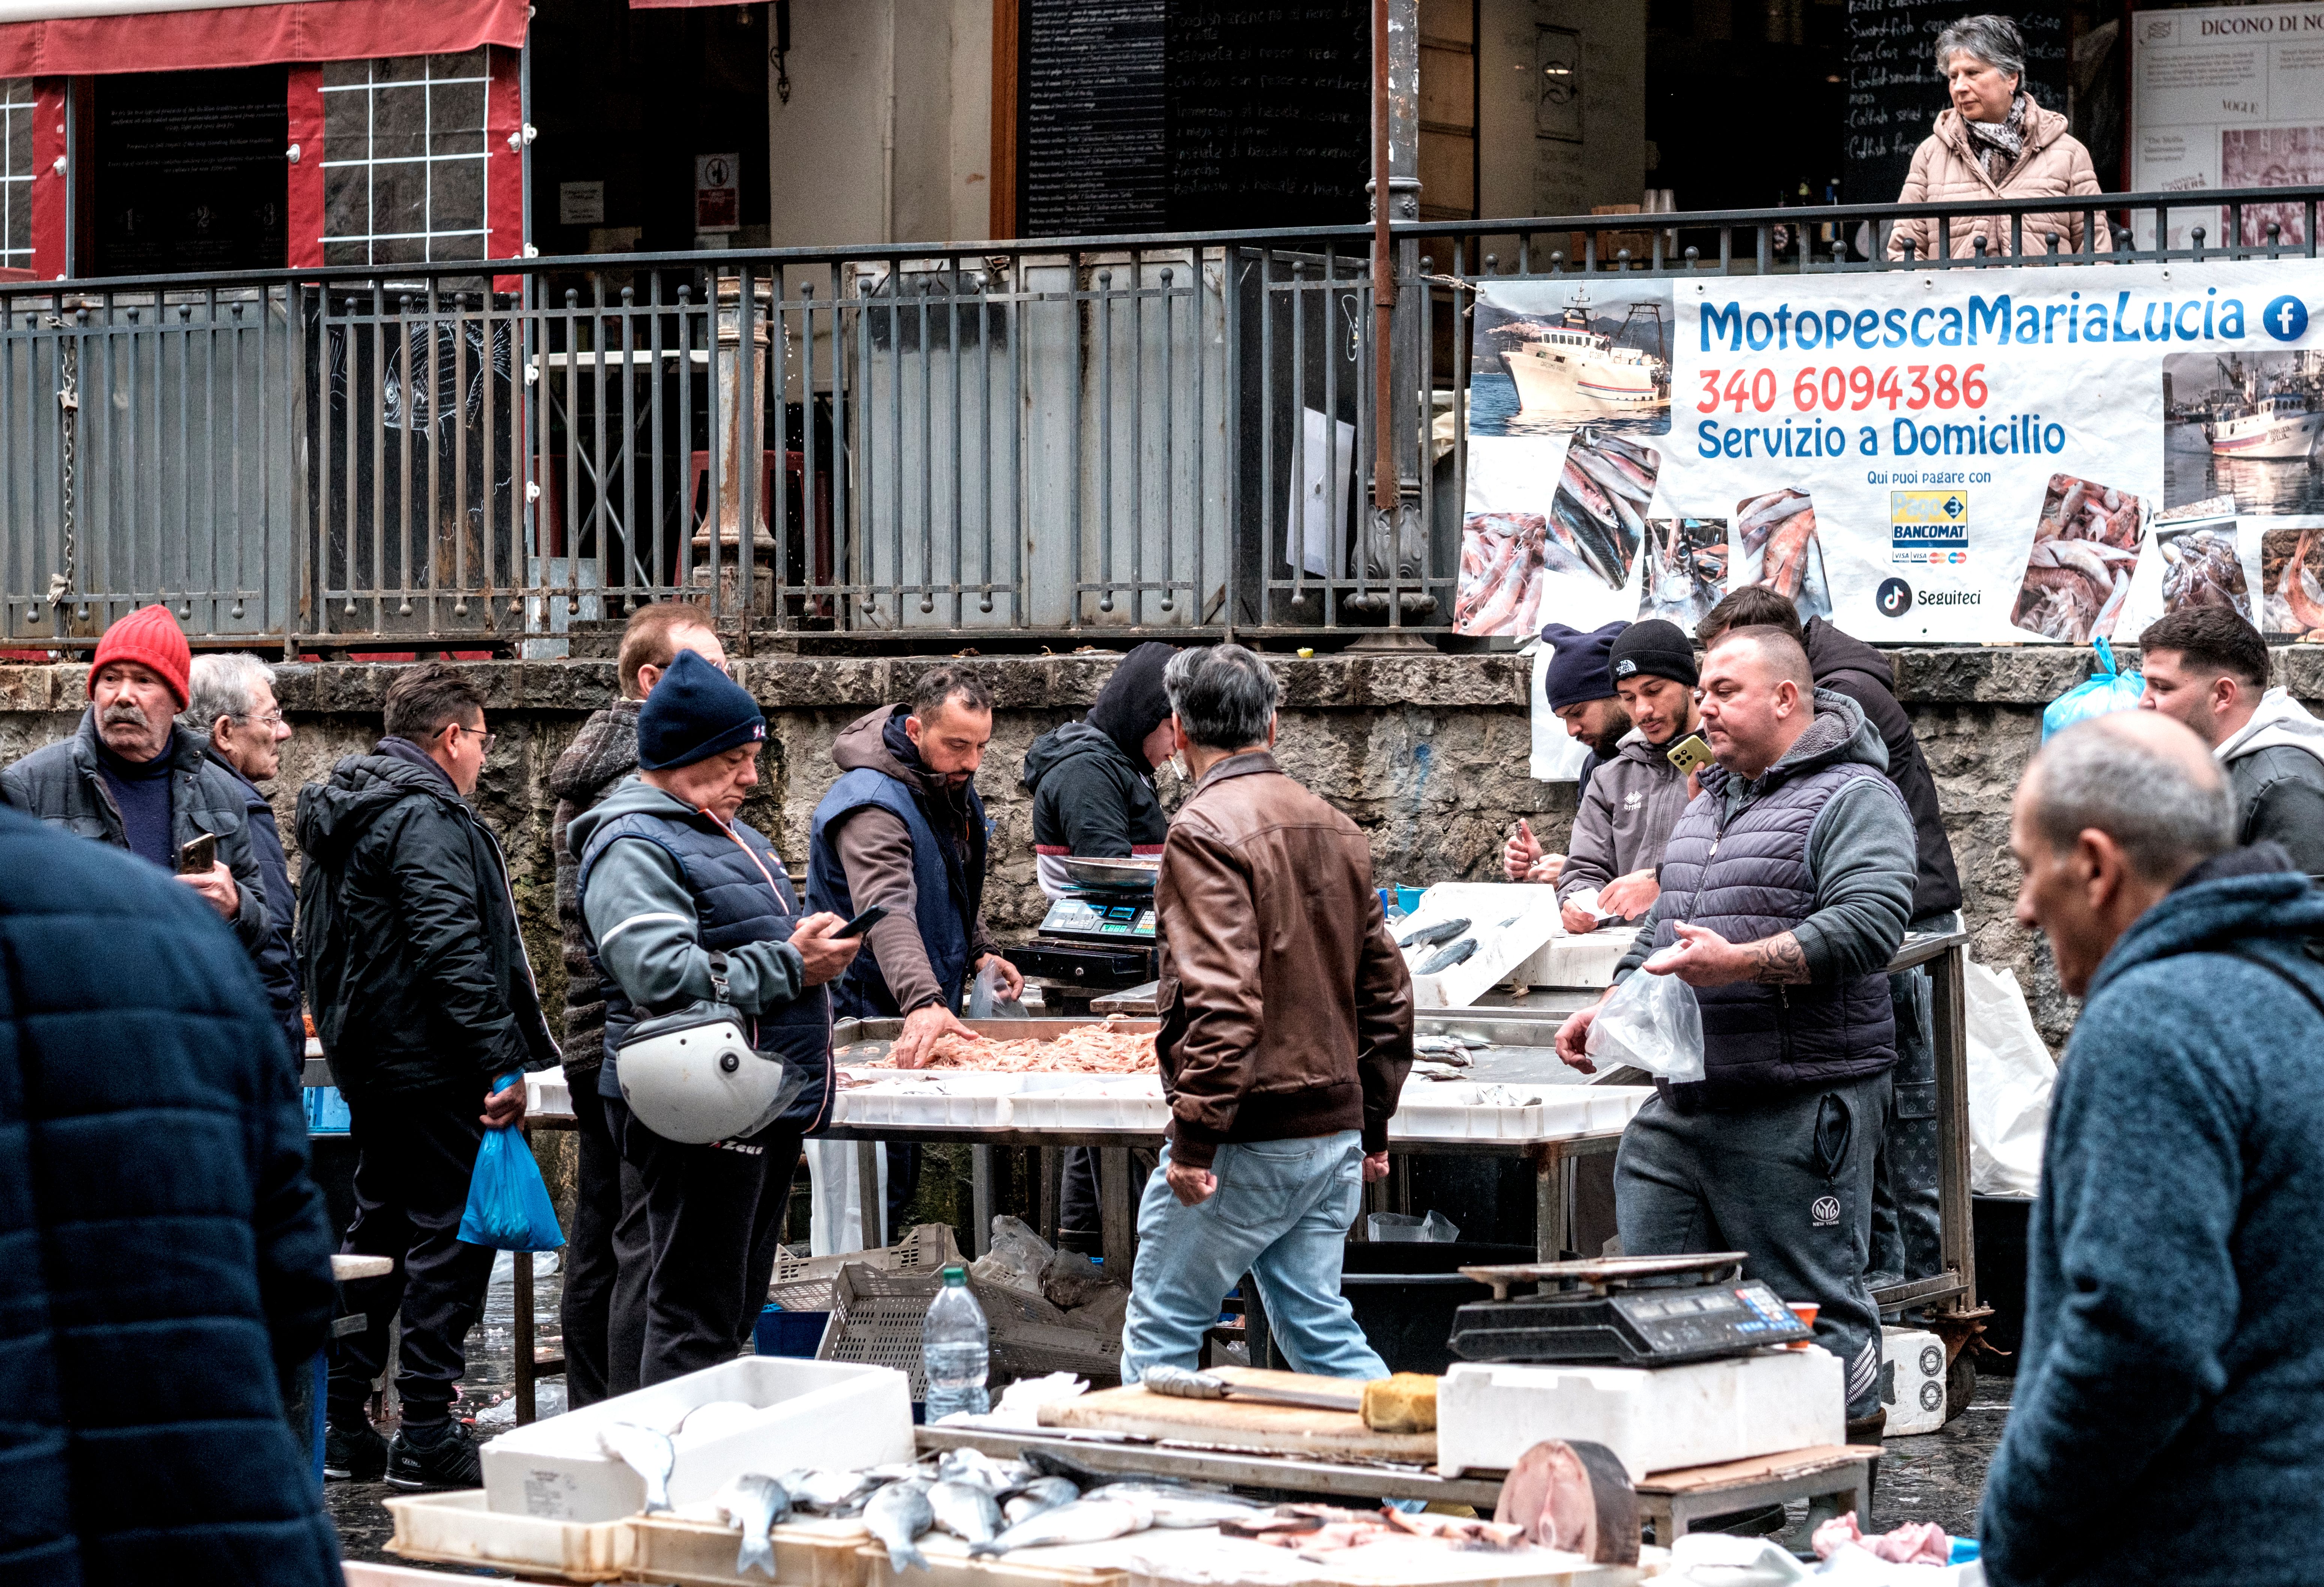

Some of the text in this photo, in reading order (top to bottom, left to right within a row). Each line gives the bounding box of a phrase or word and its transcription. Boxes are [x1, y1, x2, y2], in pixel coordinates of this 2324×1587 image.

[2201, 16, 2274, 36] DICONO
[2279, 15, 2297, 32] DI
[2222, 99, 2259, 113] VOGUE
[1700, 287, 2245, 352] MotopescaMariaLucia
[1696, 363, 1988, 414] 340 6094386
[1698, 414, 2066, 459] Servizio a Domicilio
[1867, 470, 1991, 485] Qui puoi pagare con
[1893, 492, 1942, 521] Pago
[1894, 525, 1966, 539] BANCOMAT
[1918, 590, 1981, 605] Seguiteci
[721, 1140, 763, 1155] Zeus
